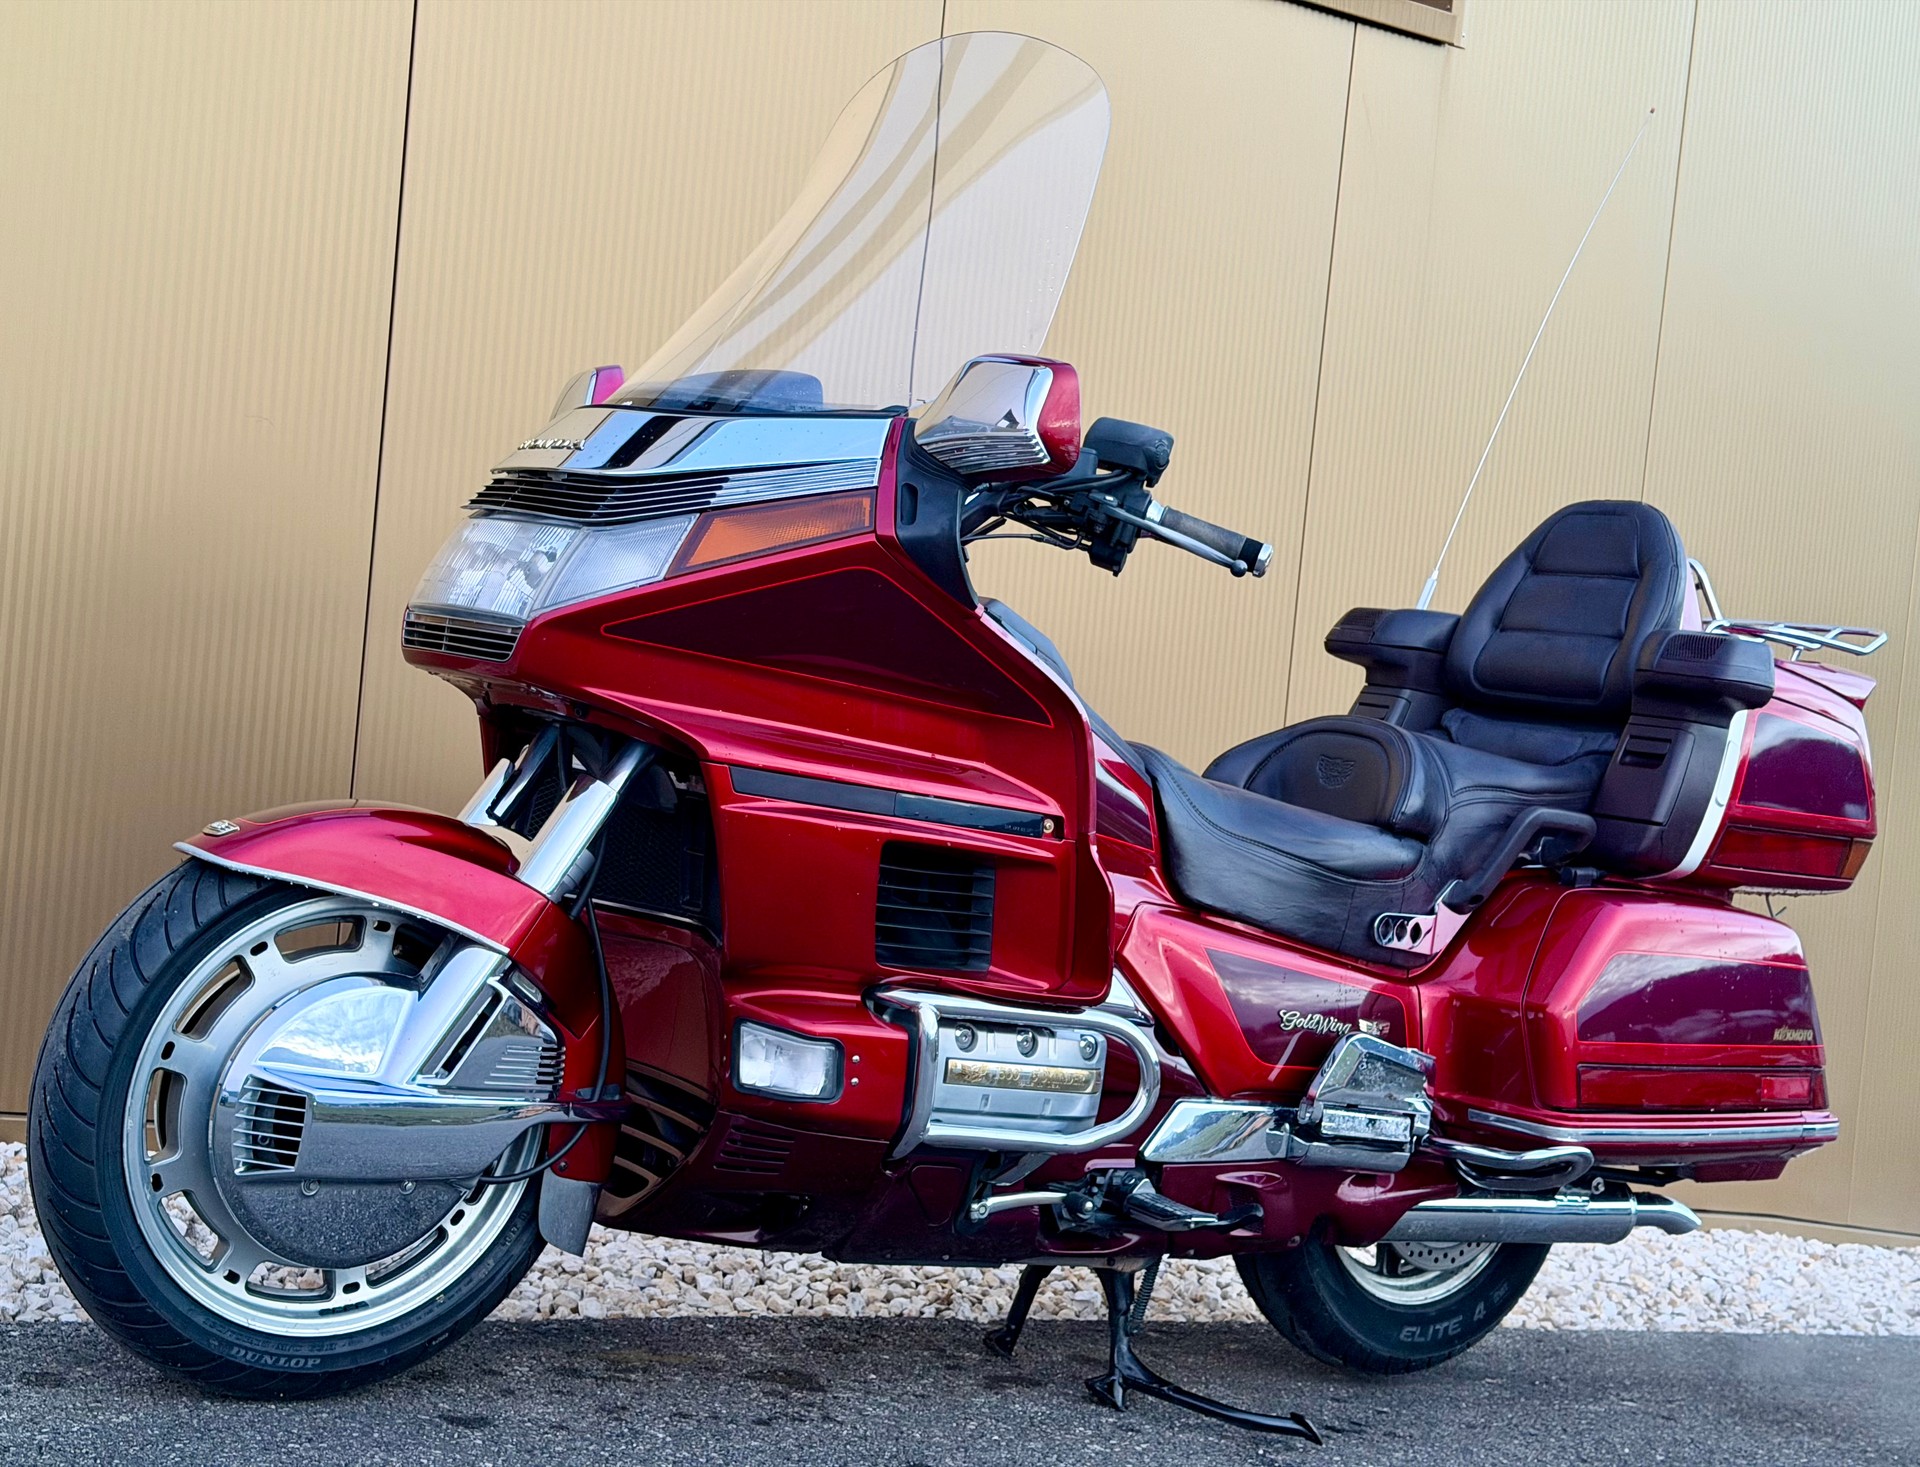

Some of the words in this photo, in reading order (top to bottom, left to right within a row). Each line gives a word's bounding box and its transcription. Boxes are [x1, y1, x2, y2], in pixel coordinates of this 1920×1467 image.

[1278, 1009, 1353, 1035] GoldWing
[1400, 1315, 1463, 1342] ELITE
[1473, 1301, 1487, 1322] 4
[231, 1346, 321, 1368] DUNLOP
